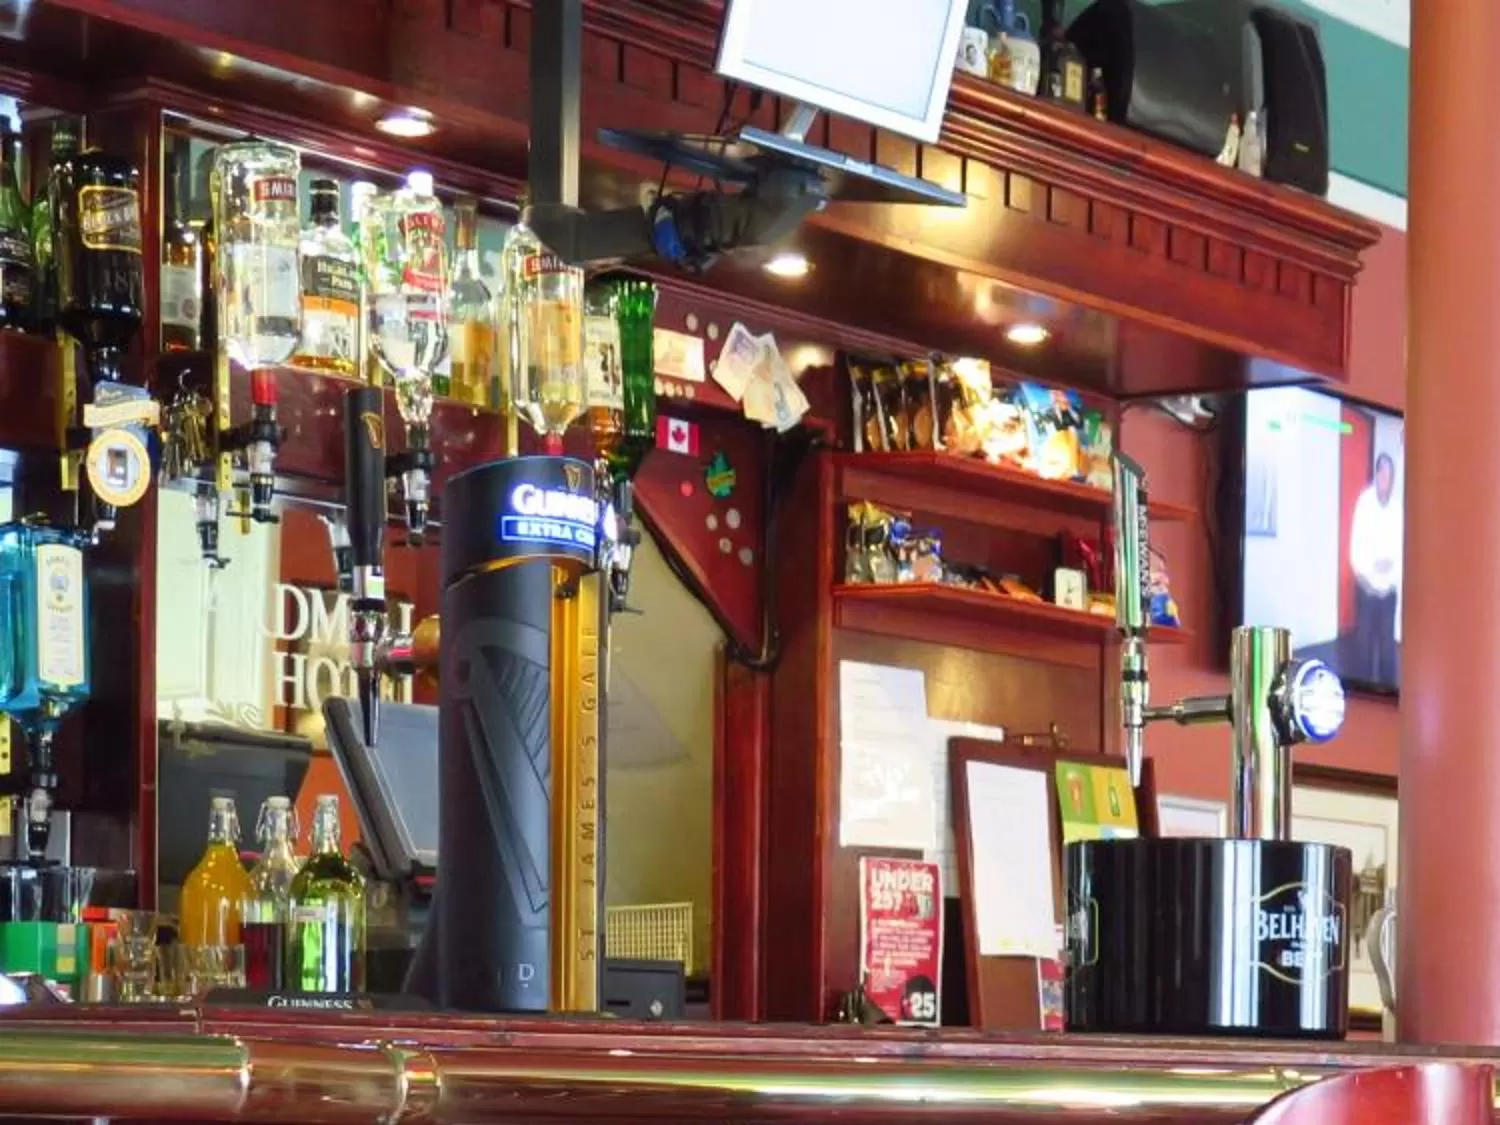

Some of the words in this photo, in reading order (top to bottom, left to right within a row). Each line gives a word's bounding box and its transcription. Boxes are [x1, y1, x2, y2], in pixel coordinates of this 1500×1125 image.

[871, 867, 934, 893] UNDER
[266, 995, 354, 1010] GUINNESS
[909, 991, 936, 1020] 25
